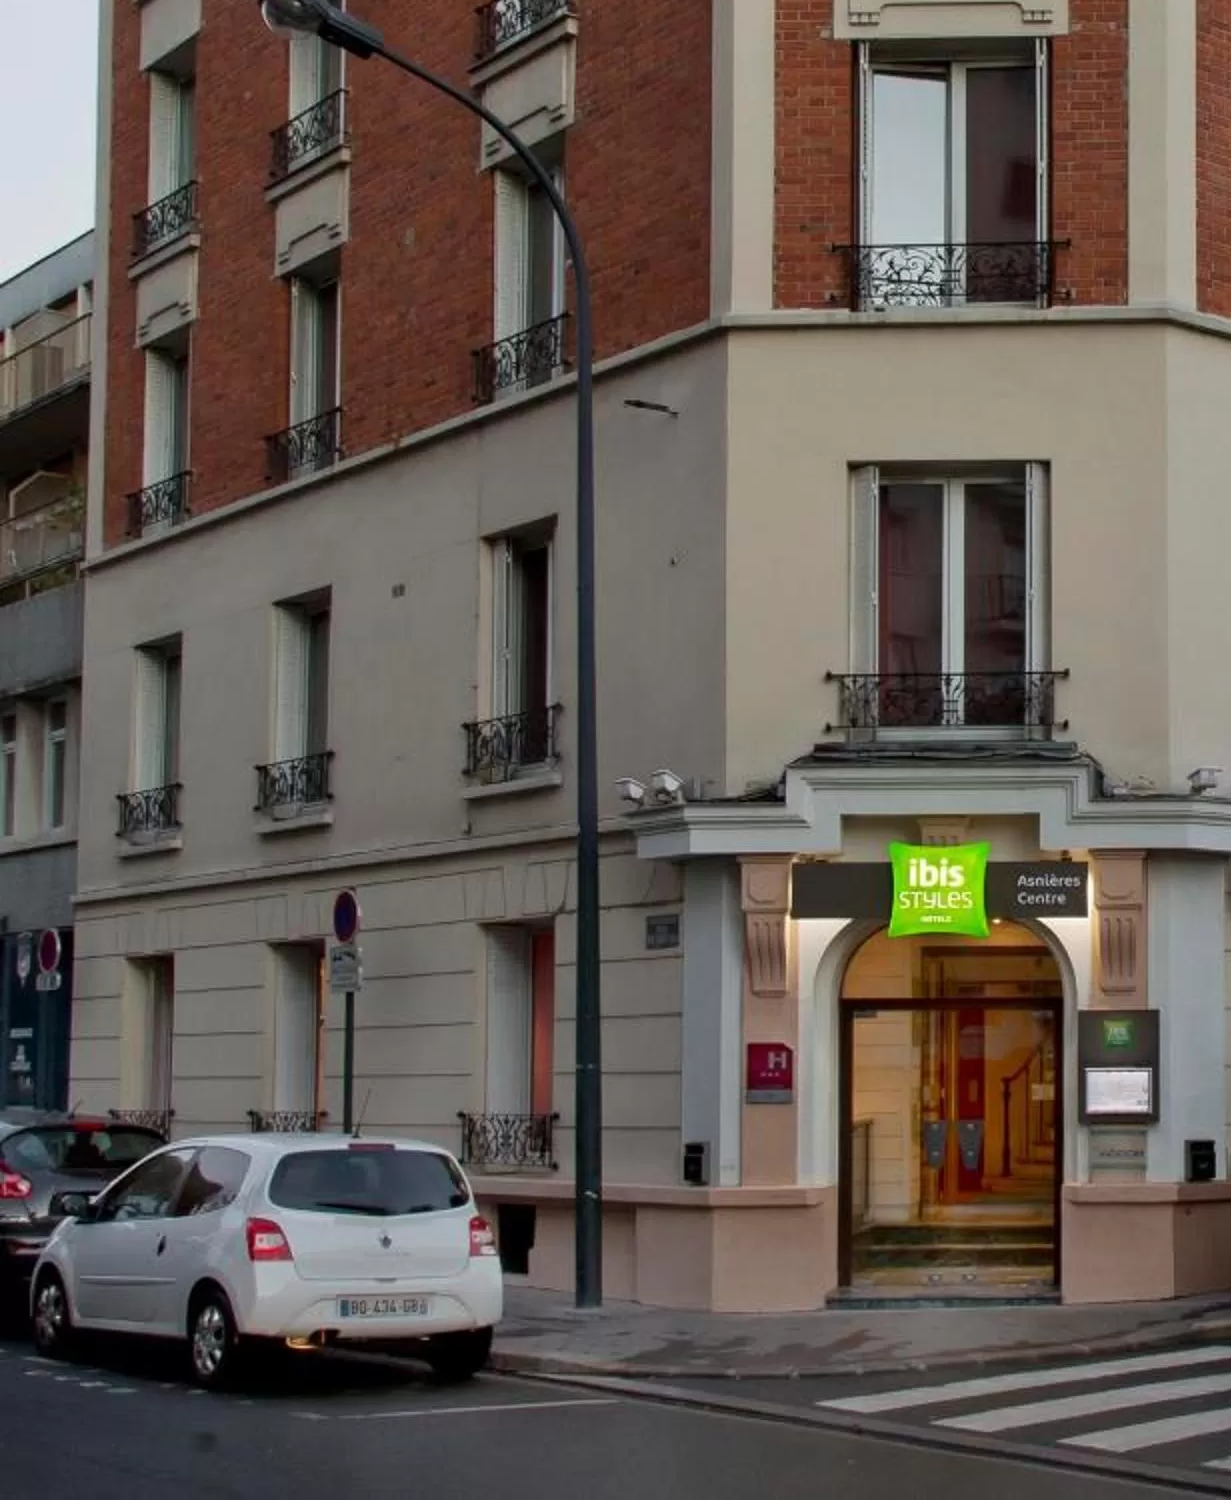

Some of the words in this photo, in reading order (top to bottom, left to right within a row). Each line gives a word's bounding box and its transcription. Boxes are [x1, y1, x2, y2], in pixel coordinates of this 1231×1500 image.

[908, 857, 965, 887] ibis
[1017, 873, 1081, 887] Asnières
[1017, 891, 1067, 905] Centre
[767, 1051, 788, 1070] H
